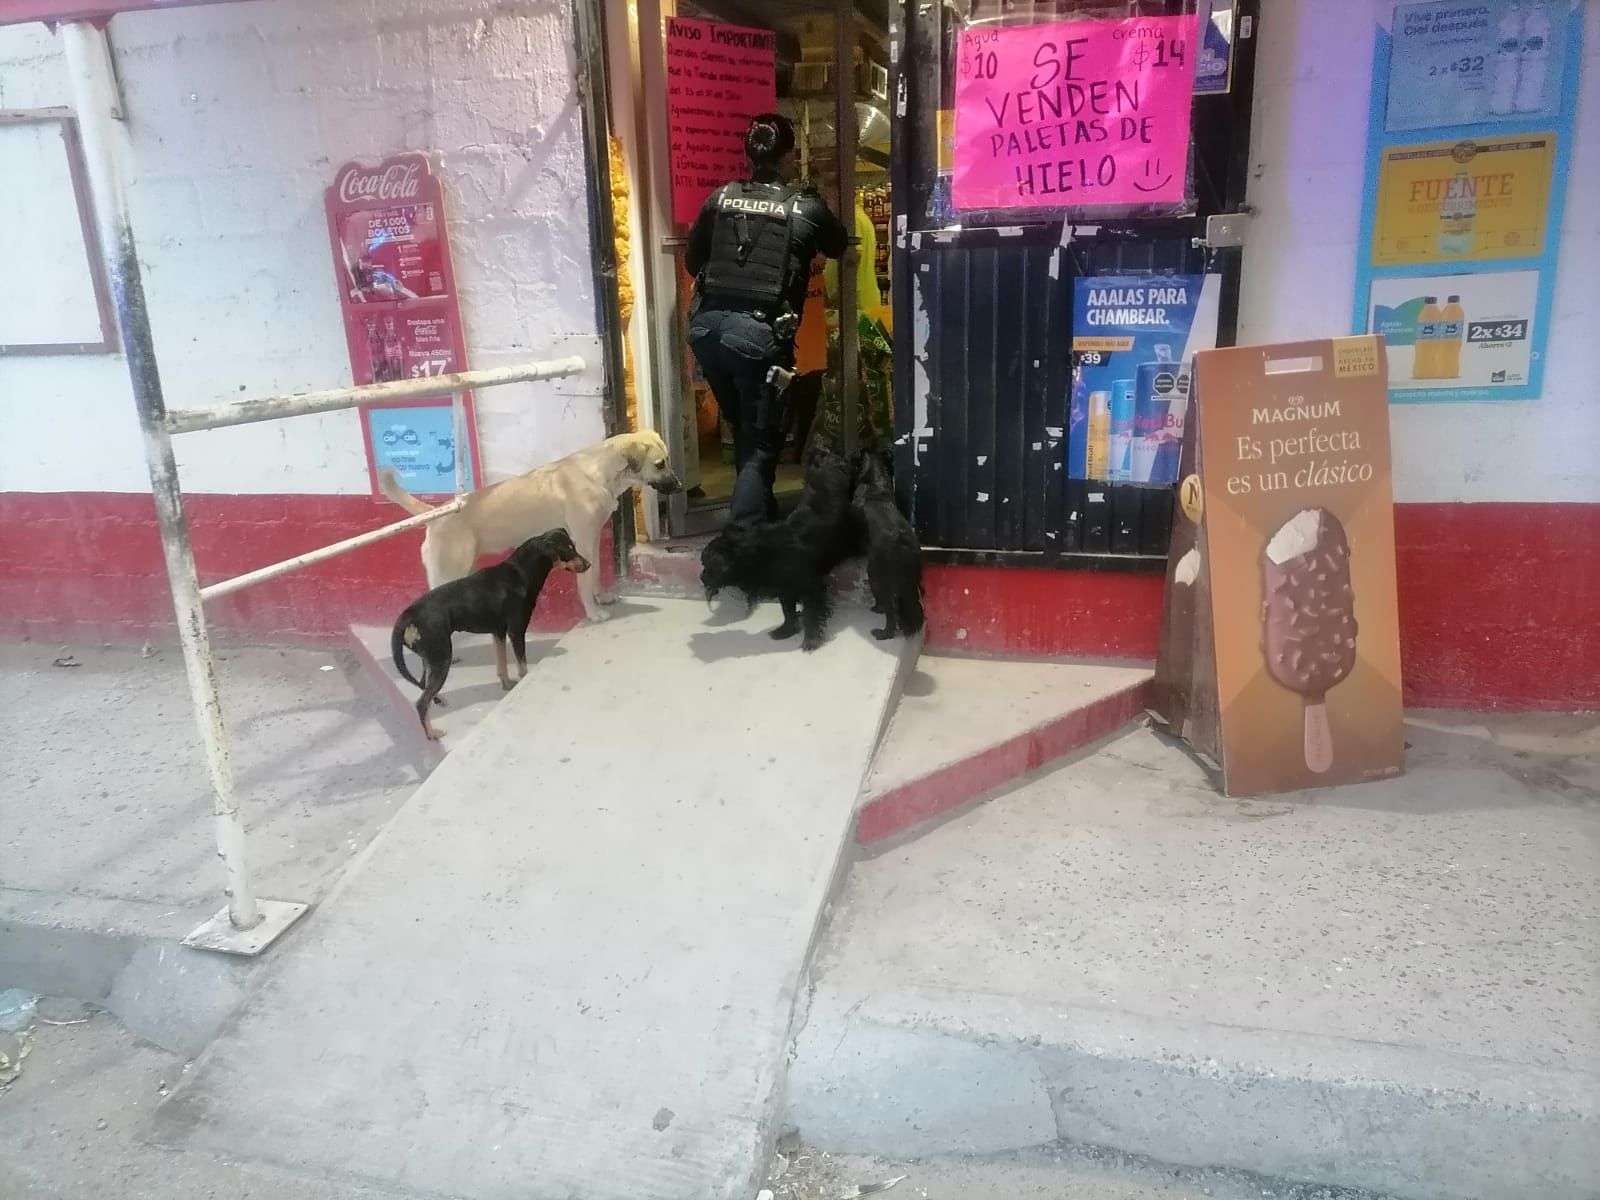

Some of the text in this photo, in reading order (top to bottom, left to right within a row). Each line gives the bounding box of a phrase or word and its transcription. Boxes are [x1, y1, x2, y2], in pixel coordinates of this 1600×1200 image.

[668, 20, 702, 41] AVISO
[963, 25, 1164, 51] Agua crema
[1030, 38, 1089, 91] SE
[985, 80, 1139, 129] VENDEN
[990, 116, 1157, 158] PALETAS DE
[1015, 154, 1116, 197] HIELO
[1408, 174, 1515, 203] FUENTE
[723, 199, 785, 215] POLICIA
[1086, 287, 1187, 306] AAALAS PARA
[1086, 308, 1170, 326] CHAMBEAR.
[411, 360, 447, 378] $17
[1252, 400, 1342, 425] MAGNUM
[1237, 428, 1361, 464] Es perfecta
[1227, 459, 1374, 495] es un clásico
